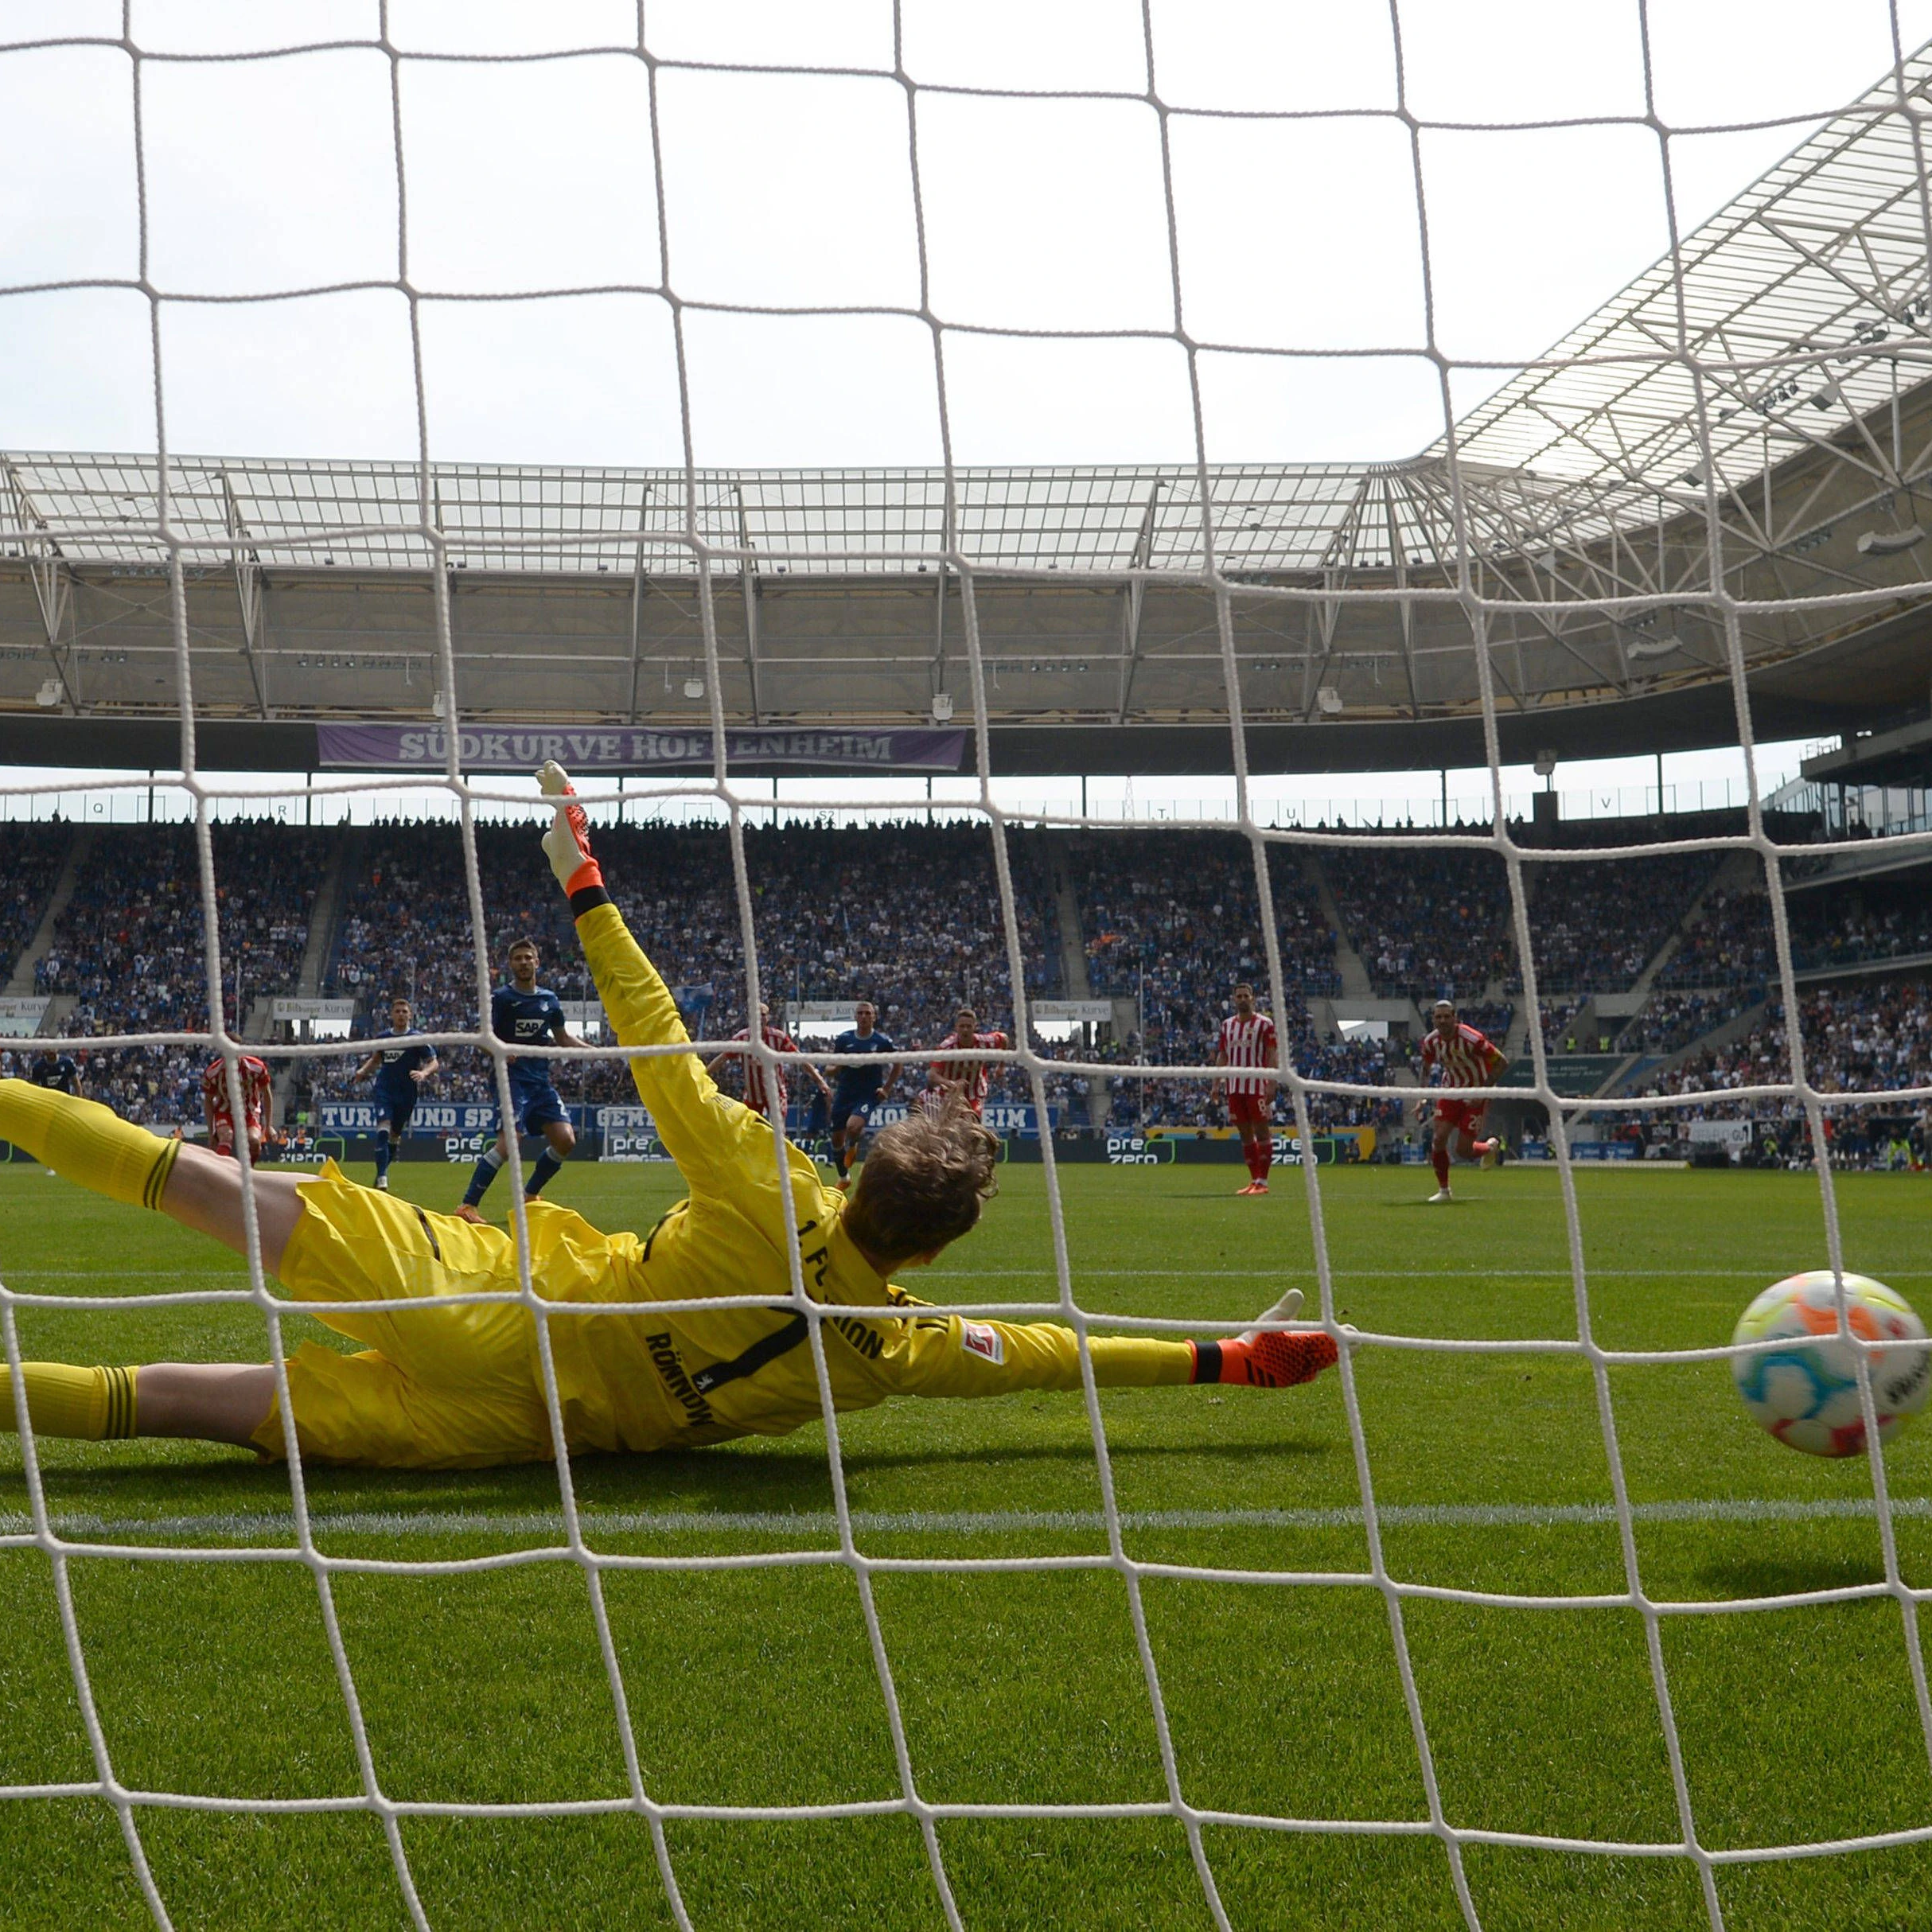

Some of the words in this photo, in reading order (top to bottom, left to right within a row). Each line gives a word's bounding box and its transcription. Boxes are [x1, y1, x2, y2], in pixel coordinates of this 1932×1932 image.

[399, 726, 621, 762] SÜDKURVE
[631, 734, 892, 761] HOFENHEIM
[93, 803, 103, 814] Q
[1600, 797, 1611, 809] V
[279, 804, 287, 816] R
[1157, 808, 1167, 819] T
[1286, 808, 1296, 820] U
[516, 1022, 539, 1034] SAP
[860, 1103, 869, 1113] 6
[1257, 1098, 1267, 1113] 8
[411, 1108, 457, 1127] UND
[446, 1138, 484, 1153] pre
[613, 1138, 649, 1153] pre
[1107, 1139, 1143, 1154] pre
[447, 1154, 483, 1163] zer
[1109, 1154, 1158, 1164] zero
[645, 1332, 716, 1427] RÖNNOW
